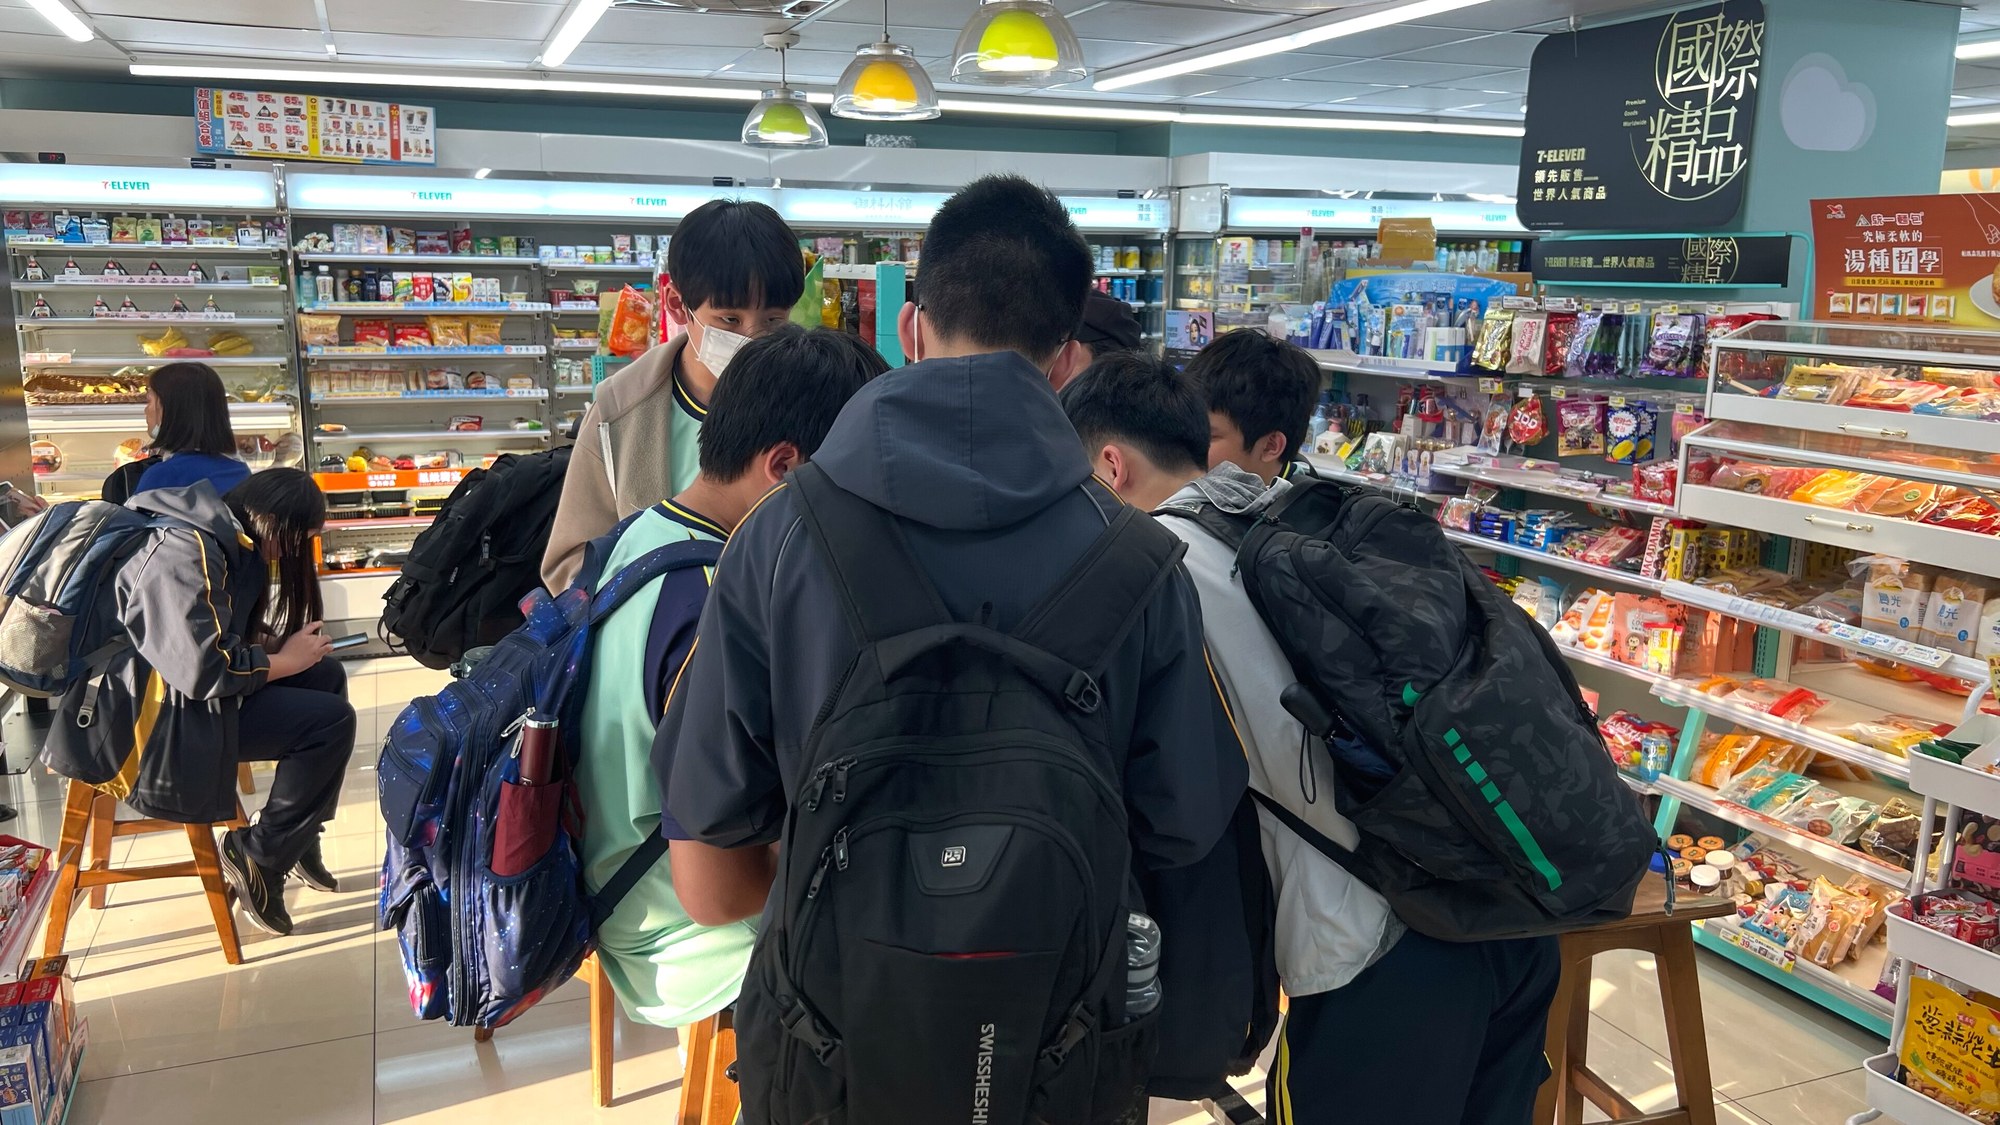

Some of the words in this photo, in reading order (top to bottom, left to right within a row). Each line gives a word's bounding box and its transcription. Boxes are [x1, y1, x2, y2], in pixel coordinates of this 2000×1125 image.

[1663, 12, 1764, 100] 國際
[1643, 101, 1747, 192] 精品
[1533, 186, 1606, 201] 世界人氣商品
[1863, 230, 1922, 243] 究極柔軟的
[1688, 237, 1732, 266] 國際
[1844, 248, 1940, 273] 湯種哲學
[1641, 516, 1663, 577] MACADAMIA
